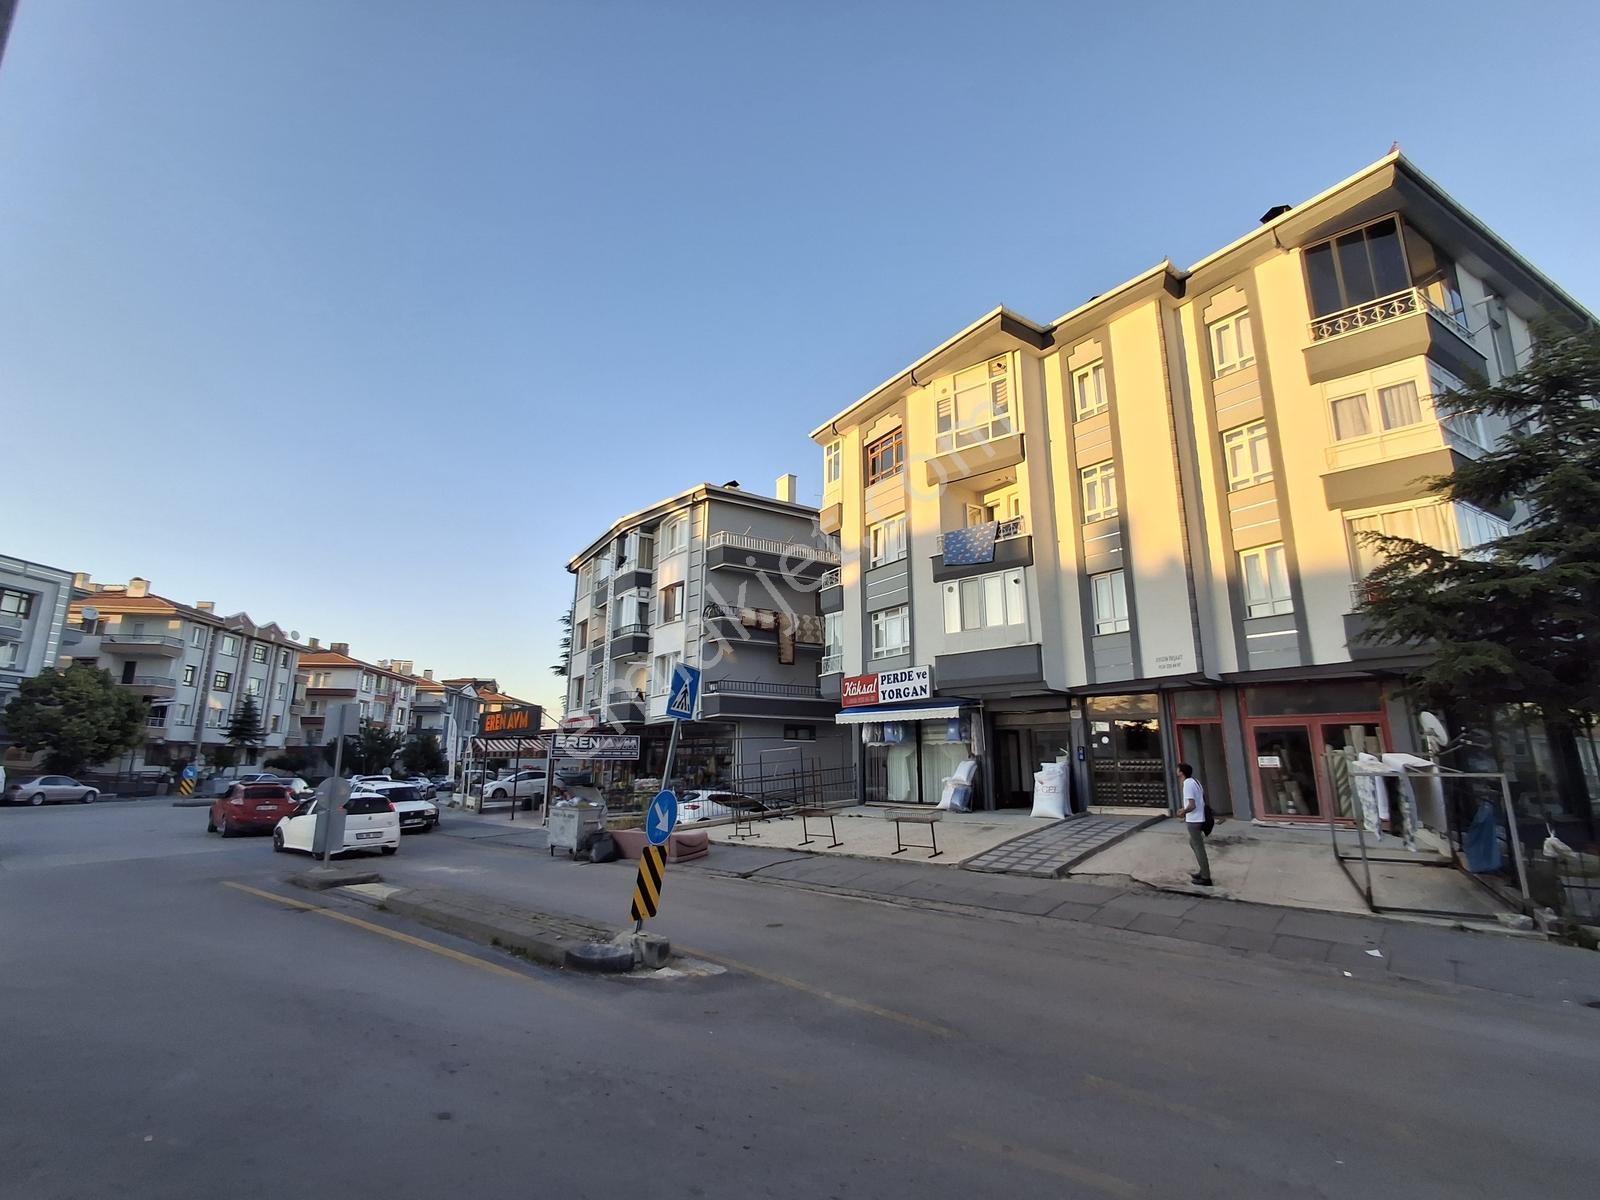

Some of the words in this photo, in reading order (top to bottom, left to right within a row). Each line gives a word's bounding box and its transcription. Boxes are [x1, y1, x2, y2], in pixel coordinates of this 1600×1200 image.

[880, 671, 914, 685] PERDE
[916, 671, 927, 680] ve
[843, 678, 877, 696] Köksal
[881, 684, 928, 700] YORGAN
[555, 735, 600, 749] EREN
